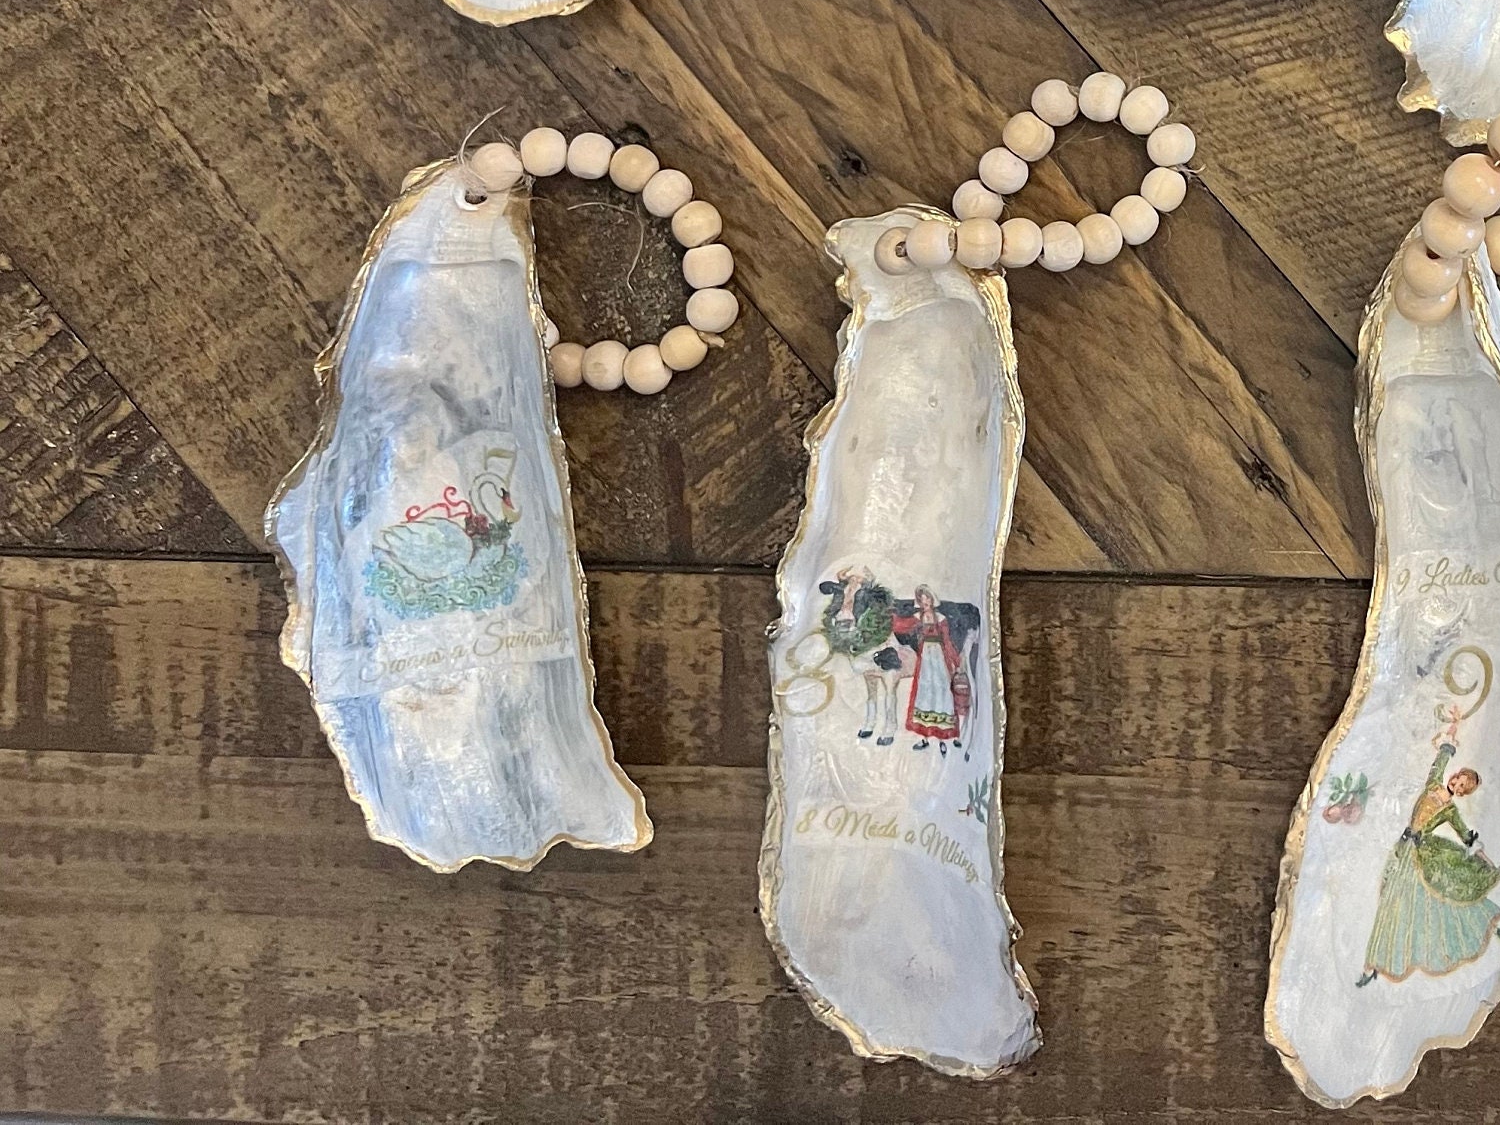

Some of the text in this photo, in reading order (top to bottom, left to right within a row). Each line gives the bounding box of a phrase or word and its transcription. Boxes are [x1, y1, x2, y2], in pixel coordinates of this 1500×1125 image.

[1397, 568, 1411, 596] 9
[1419, 557, 1490, 597] Ladies
[1434, 645, 1493, 723] 9
[796, 809, 818, 833] 8
